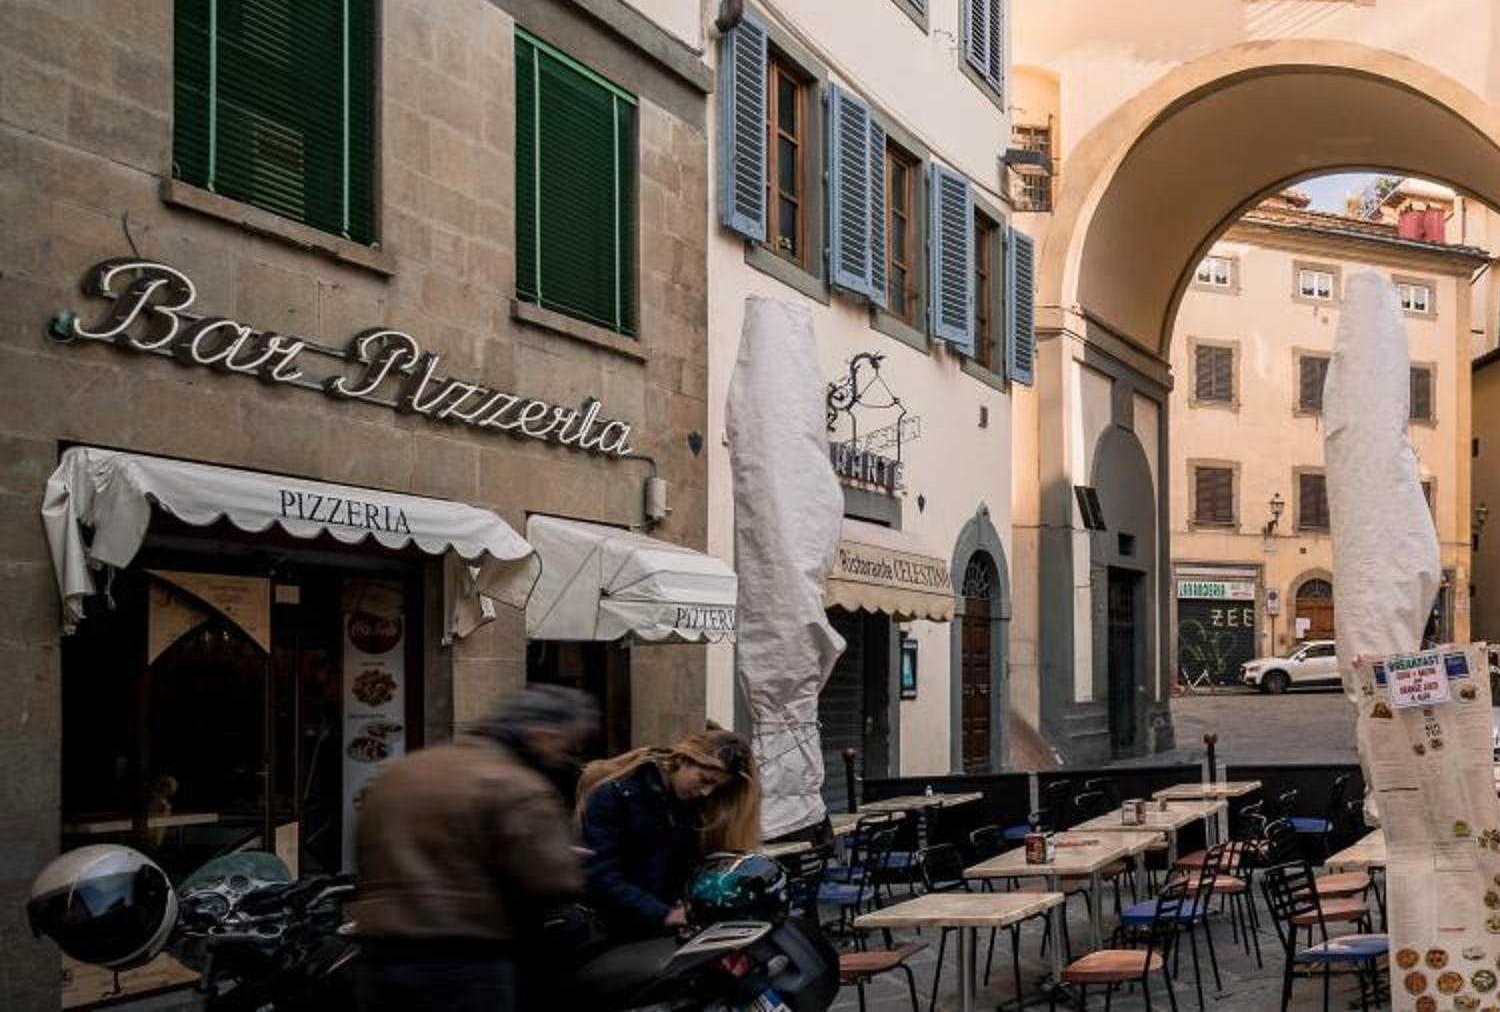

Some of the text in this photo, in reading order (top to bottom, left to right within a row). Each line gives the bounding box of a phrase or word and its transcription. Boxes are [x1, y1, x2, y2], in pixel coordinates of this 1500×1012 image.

[70, 260, 635, 457] Bar Pizzeria
[278, 488, 413, 536] PIZZERIA
